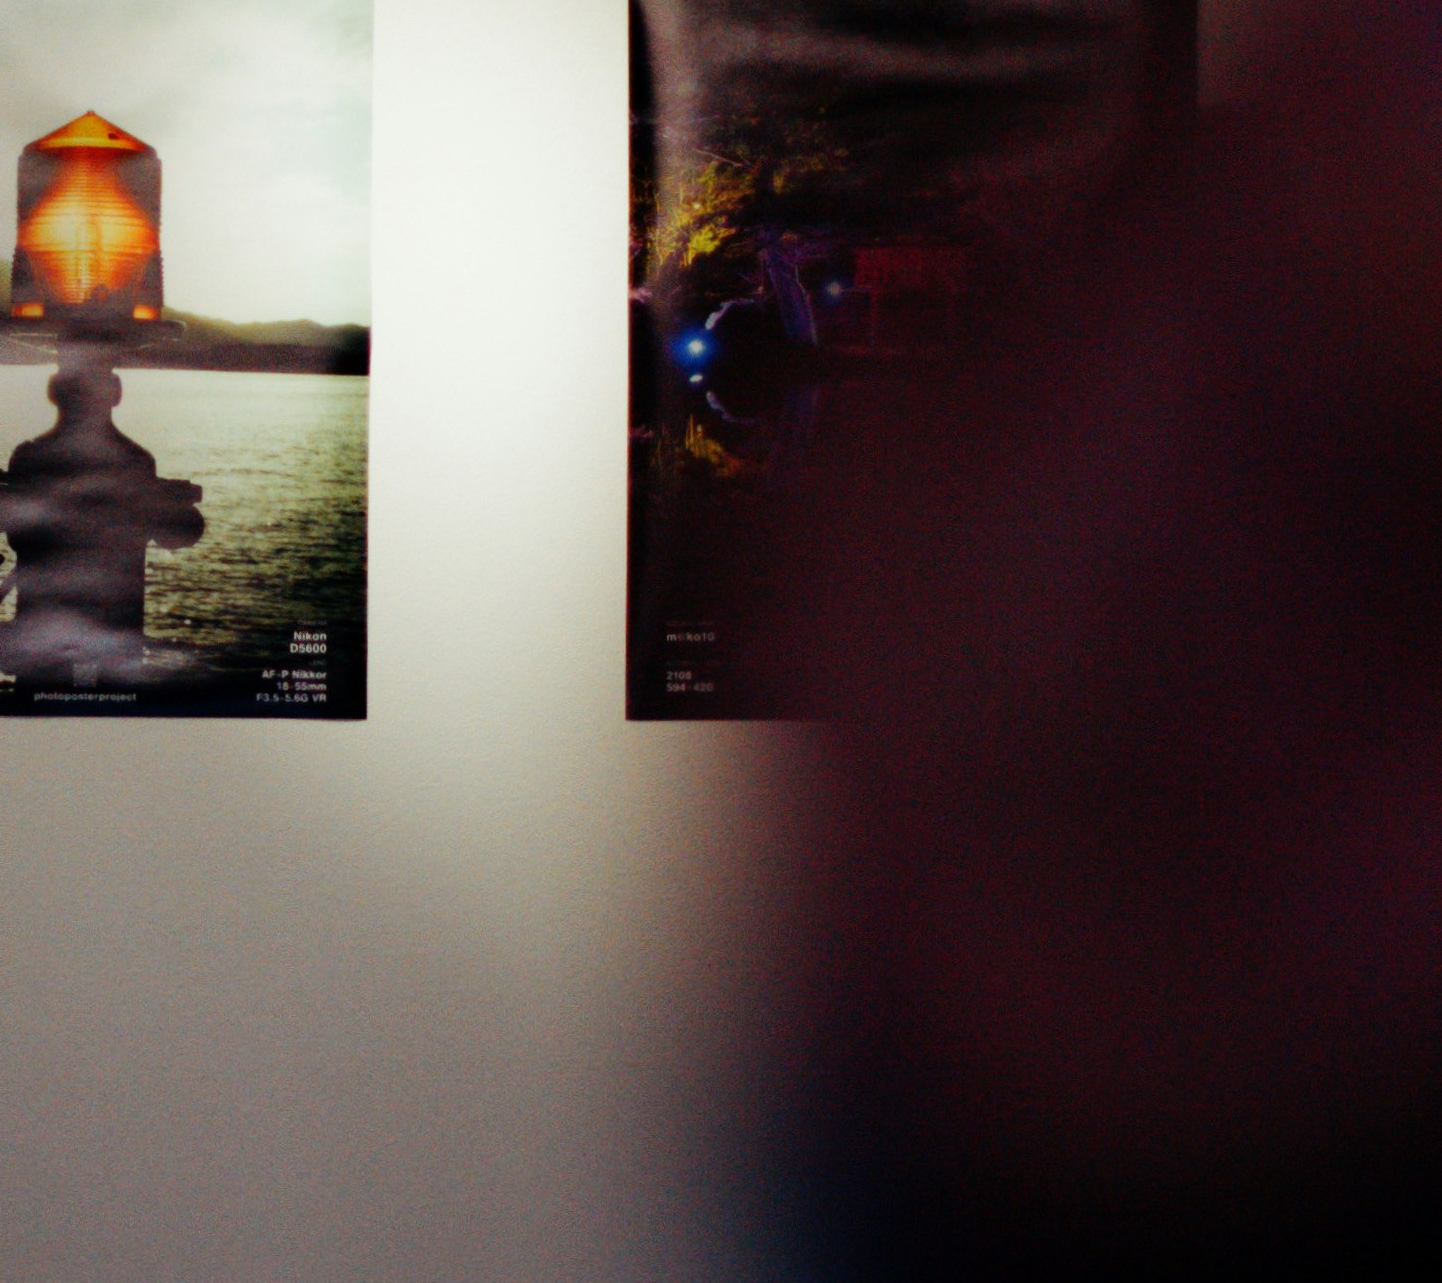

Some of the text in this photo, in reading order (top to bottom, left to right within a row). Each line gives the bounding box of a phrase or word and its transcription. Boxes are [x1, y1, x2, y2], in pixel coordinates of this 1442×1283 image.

[293, 631, 327, 641] Nikon
[290, 643, 327, 654] D5600
[262, 669, 327, 680] AF-P Nikkor
[276, 681, 327, 691] 18-55mm
[32, 691, 137, 703] photoposterproject
[312, 692, 327, 703] VR
